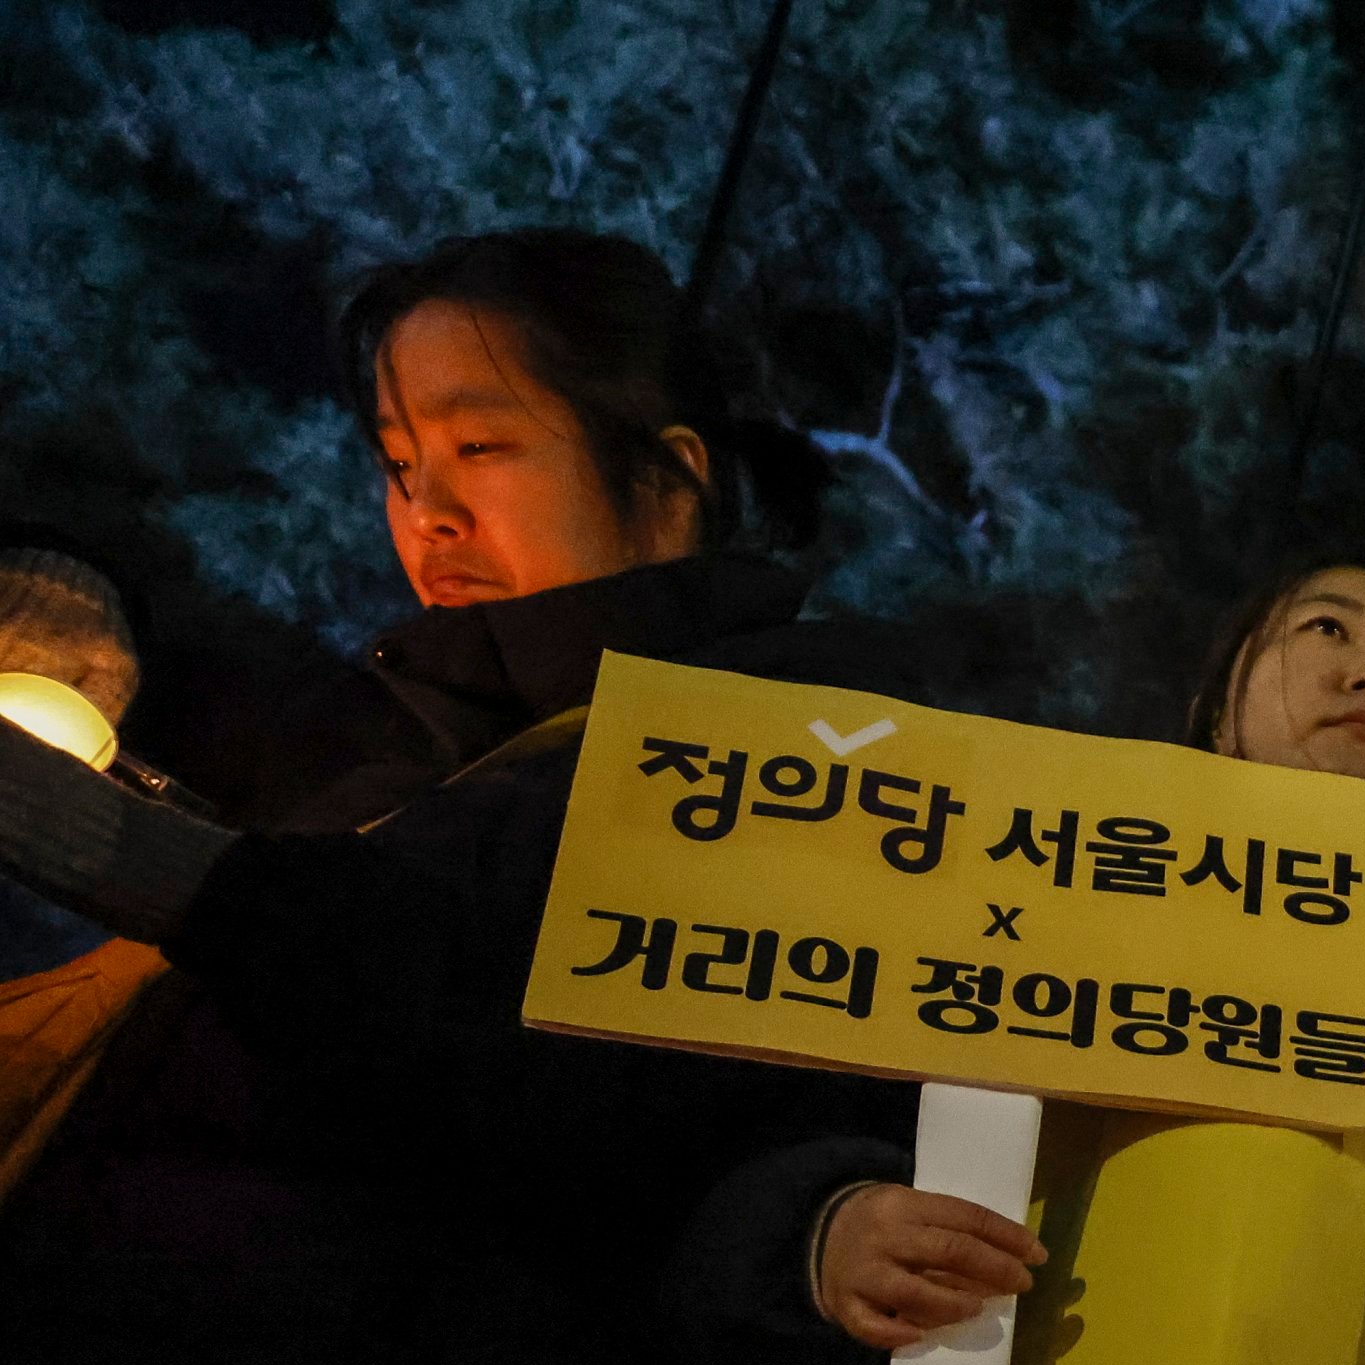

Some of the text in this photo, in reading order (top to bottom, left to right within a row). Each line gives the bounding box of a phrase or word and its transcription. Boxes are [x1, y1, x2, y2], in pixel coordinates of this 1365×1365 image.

[637, 737, 1363, 927] 정의당 서울시당
[570, 908, 880, 1020] 거리의
